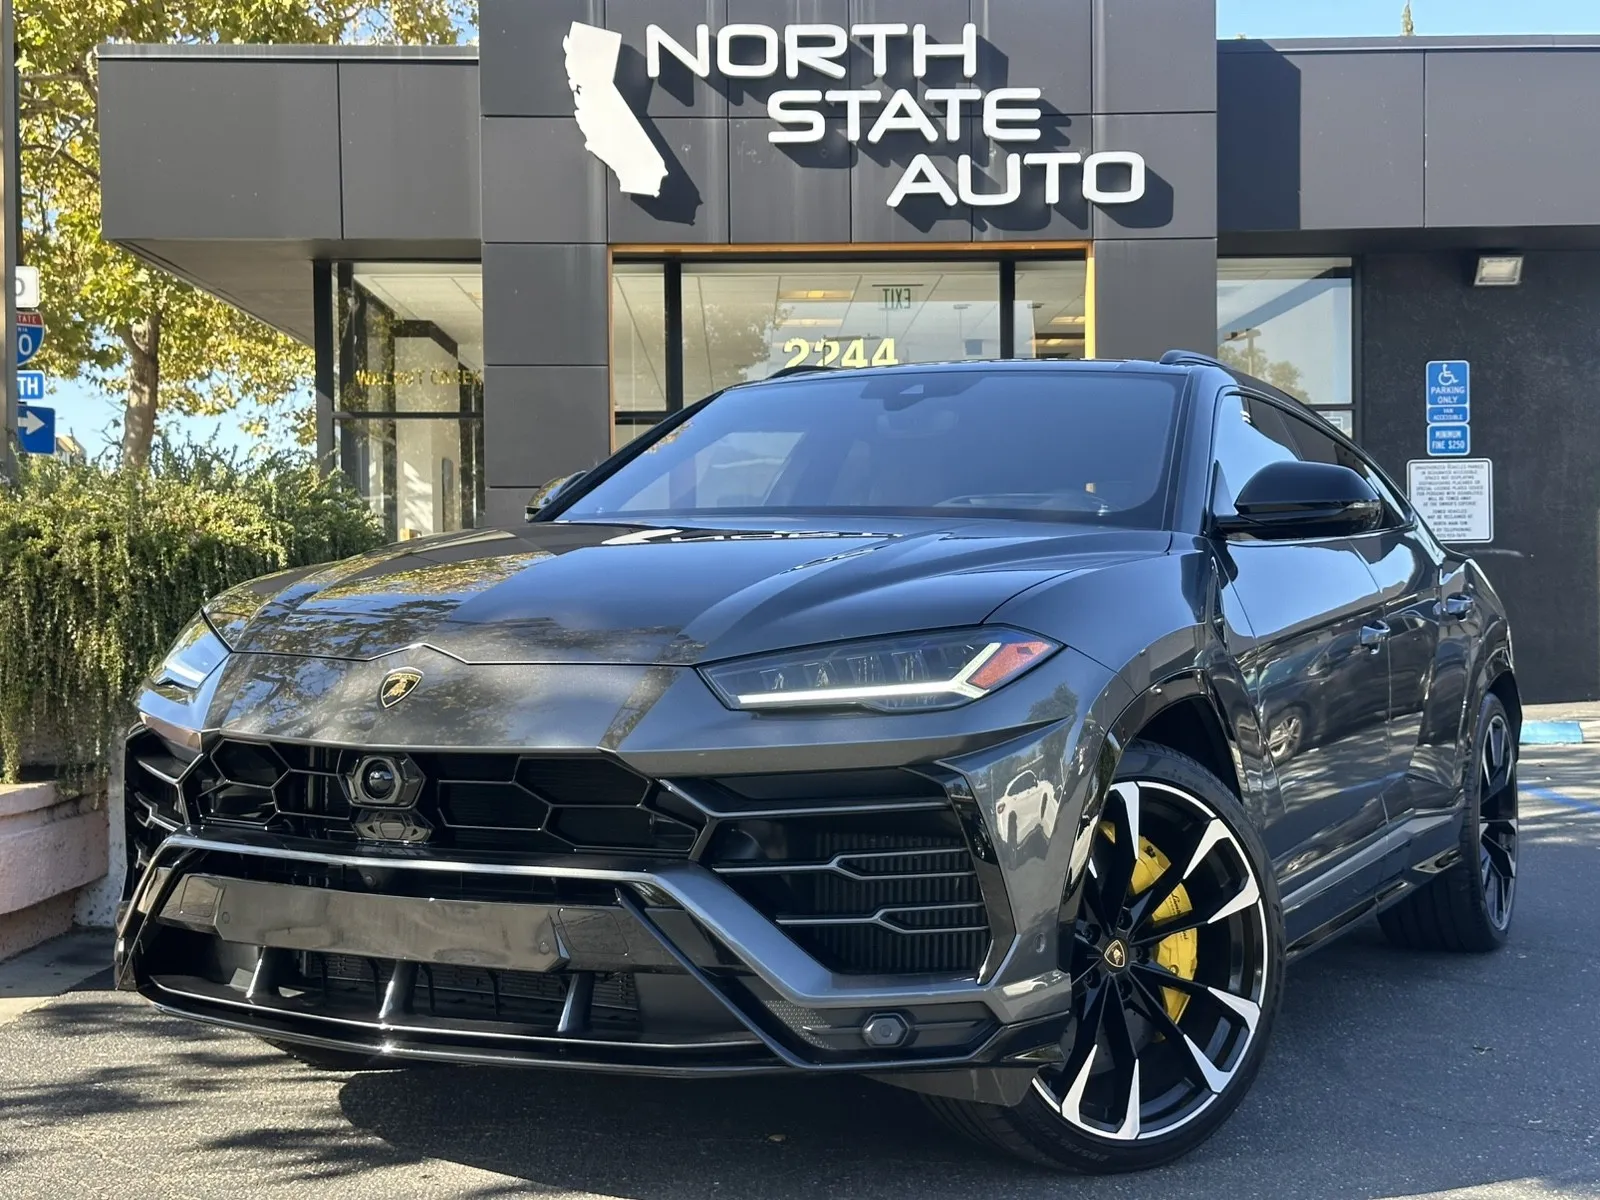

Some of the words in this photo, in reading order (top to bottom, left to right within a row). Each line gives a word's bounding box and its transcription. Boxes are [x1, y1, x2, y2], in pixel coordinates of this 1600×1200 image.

[646, 23, 978, 79] NORTH
[767, 87, 1042, 144] STATE
[886, 151, 1146, 207] AUTO
[783, 337, 899, 368] 2244
[1430, 386, 1465, 395] PARKING
[1437, 396, 1458, 404] ONLY
[1432, 440, 1446, 450] FINE
[1448, 440, 1465, 450] $250
